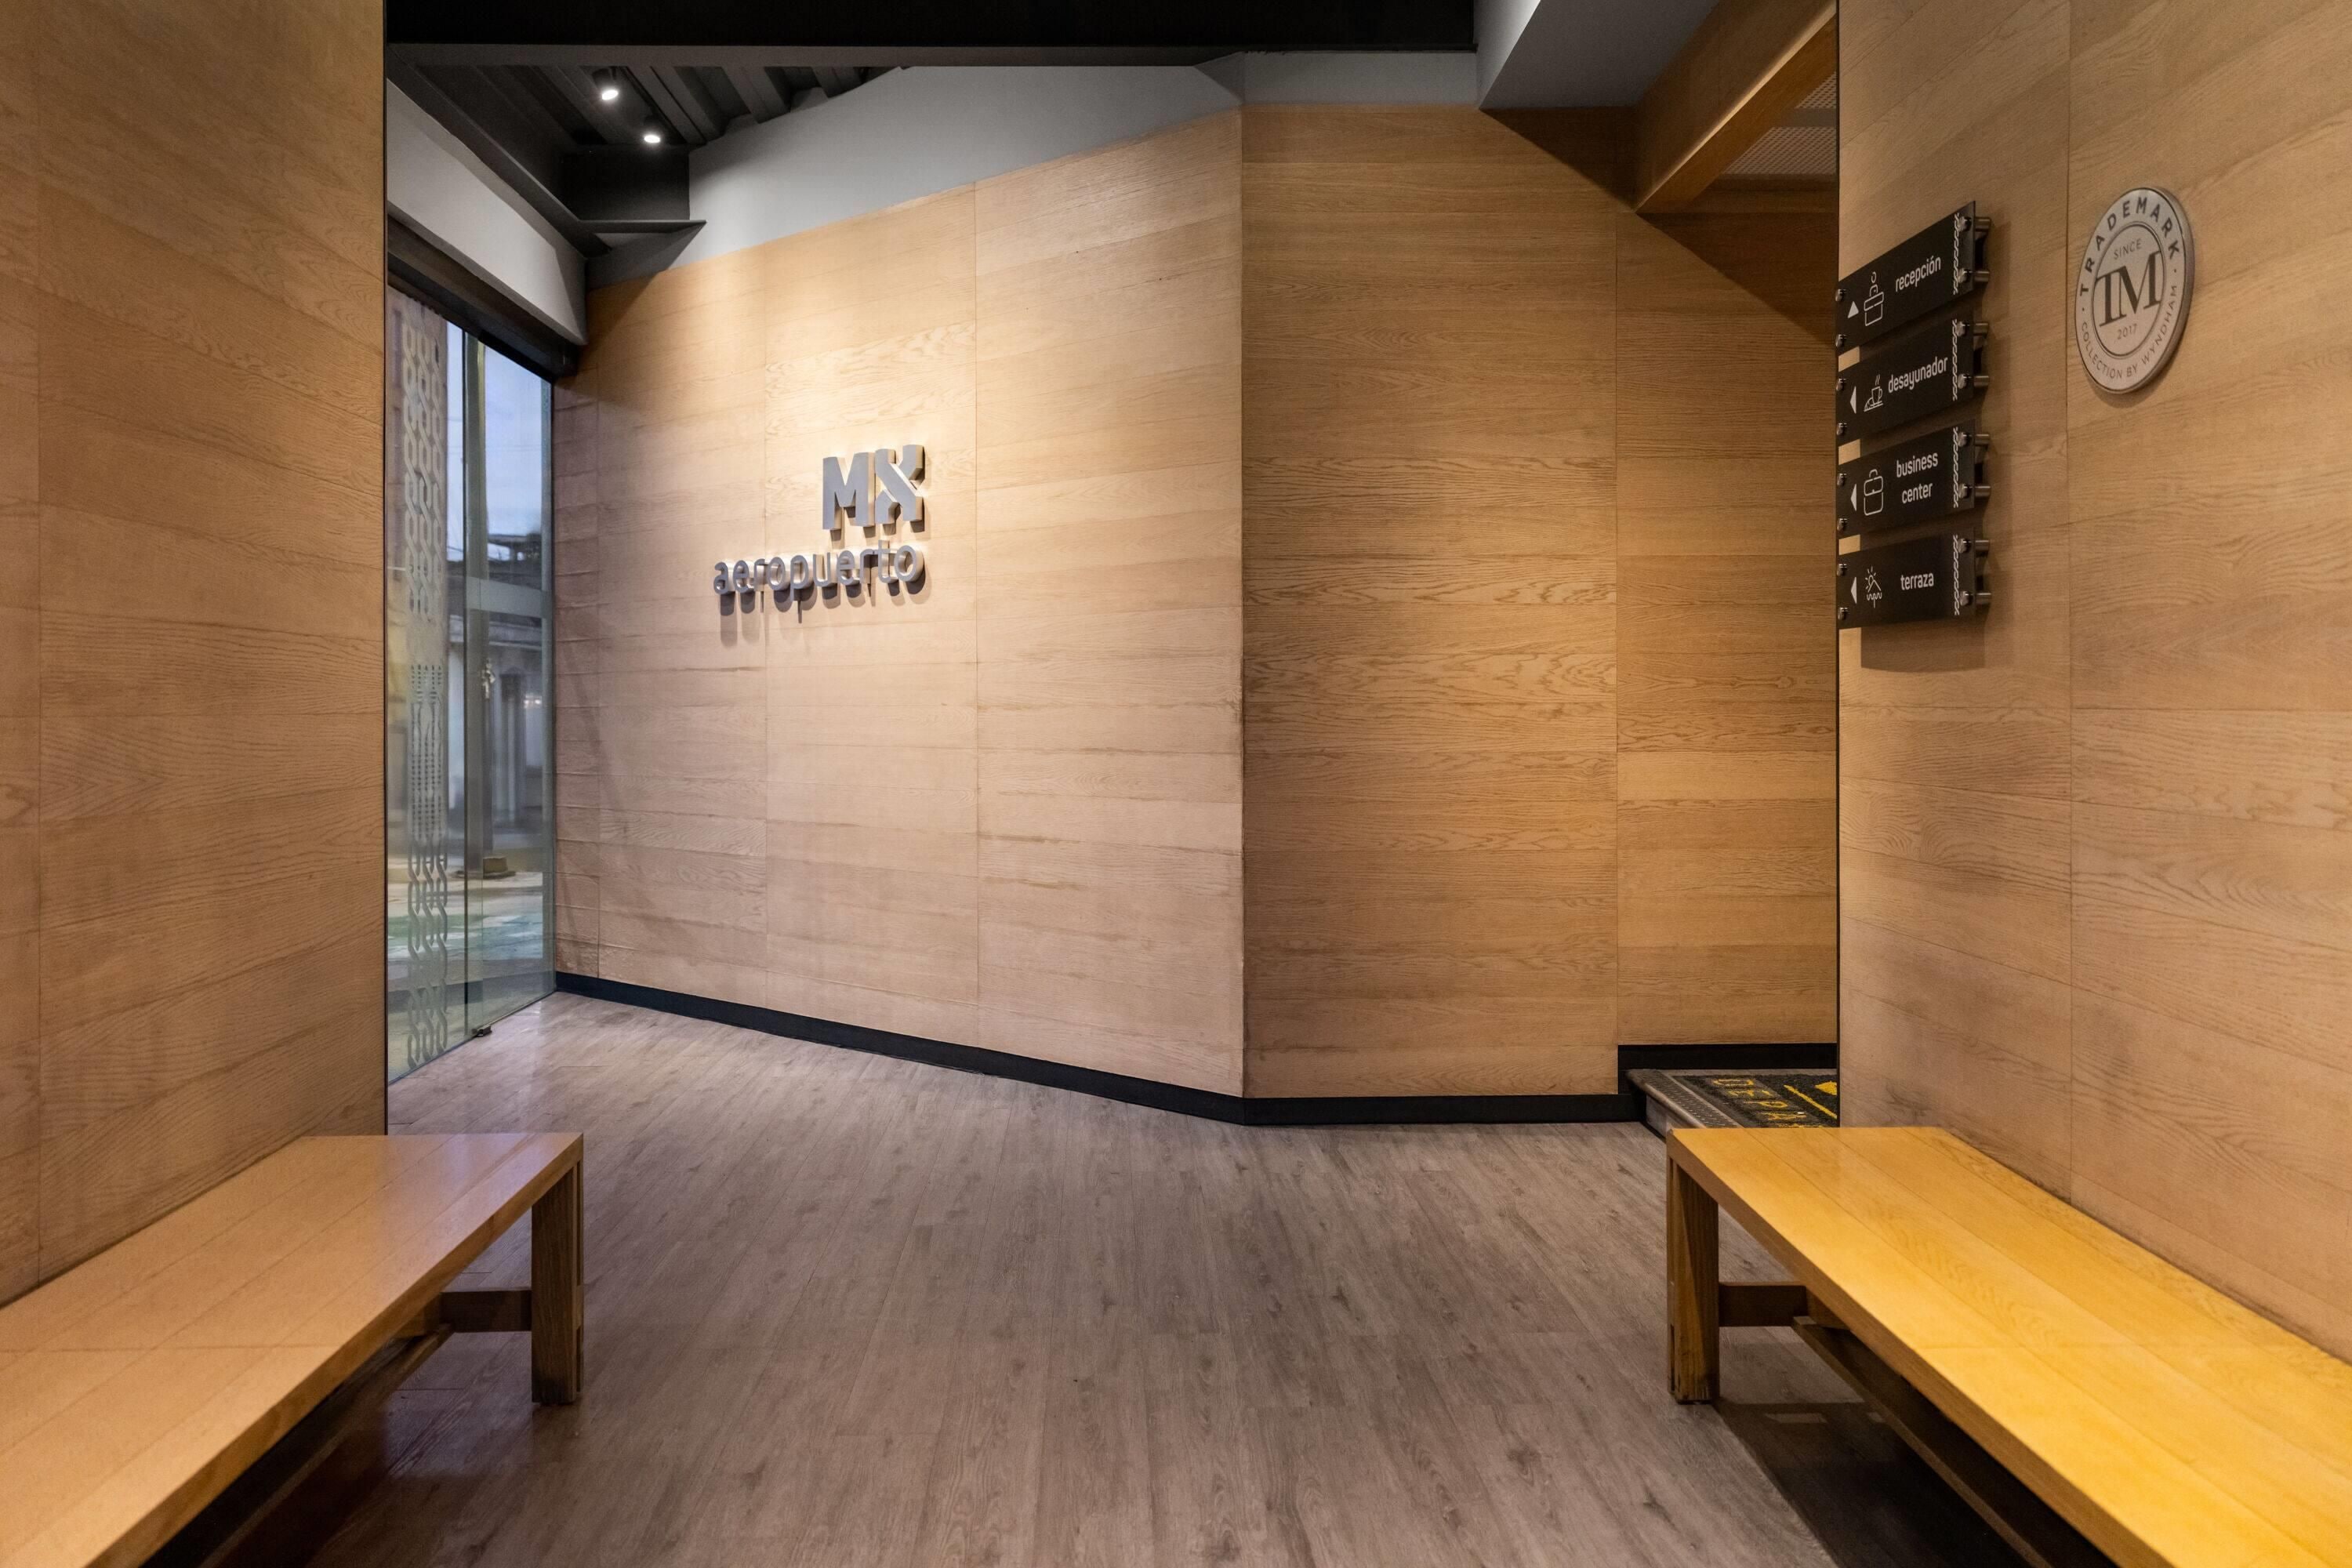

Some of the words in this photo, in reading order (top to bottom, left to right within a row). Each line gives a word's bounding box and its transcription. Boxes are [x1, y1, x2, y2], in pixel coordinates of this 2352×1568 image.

[2079, 196, 2180, 296] TRADEMARK
[2113, 238, 2142, 260] SINCE
[1895, 255, 1942, 292] recepción
[2082, 321, 2123, 379] COLLECTION
[2125, 363, 2138, 378] BY
[2141, 285, 2178, 367] WYNDHAM
[2116, 322, 2138, 340] 2017
[1888, 355, 1948, 394] desayunador
[1896, 452, 1939, 478] business
[822, 444, 925, 530] MX
[1901, 482, 1933, 504] center
[713, 539, 924, 602] aeropuerto
[1900, 572, 1934, 591] terraza
